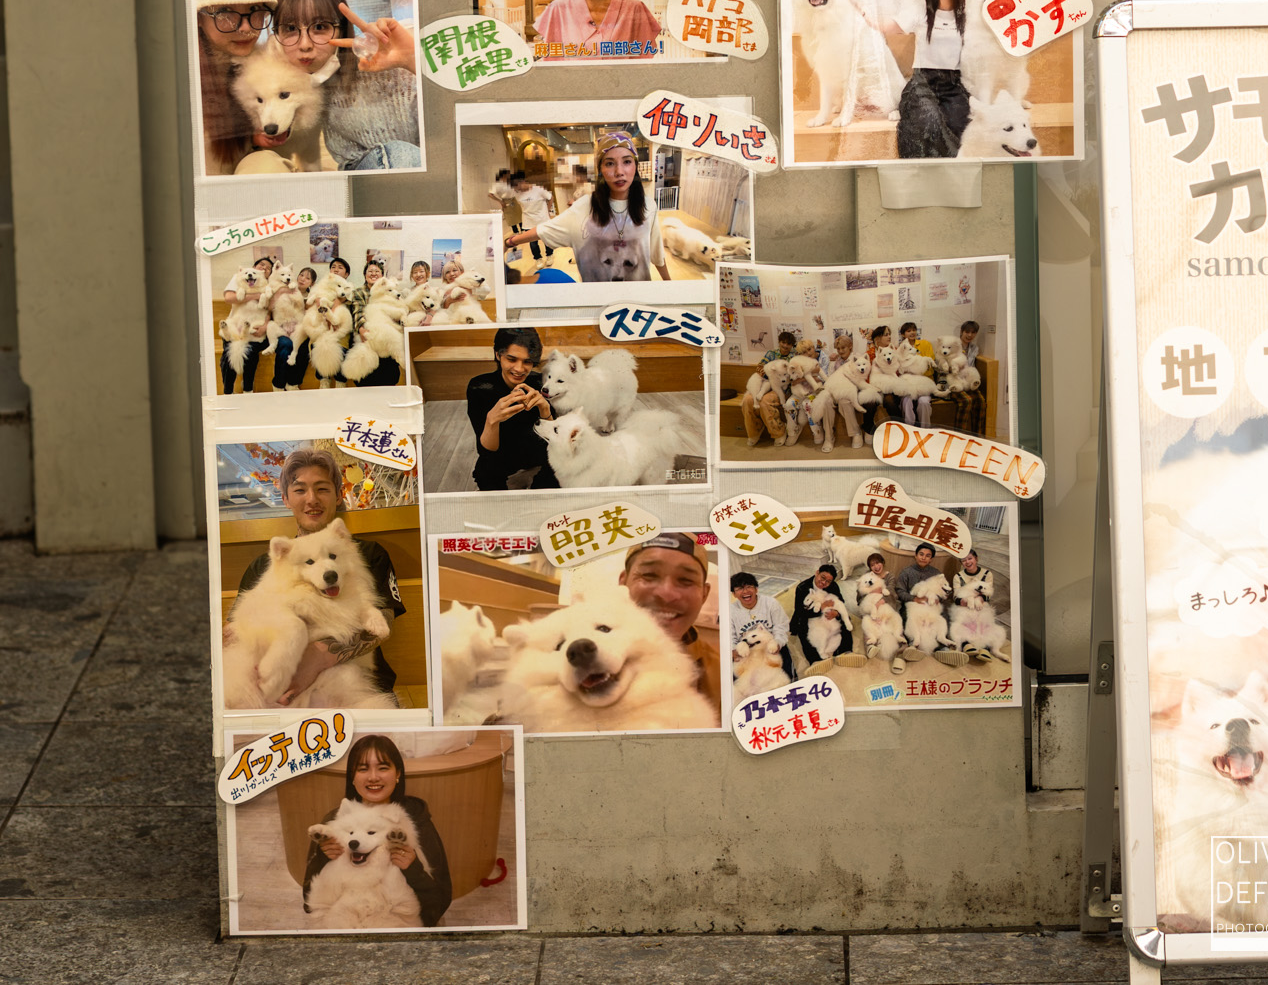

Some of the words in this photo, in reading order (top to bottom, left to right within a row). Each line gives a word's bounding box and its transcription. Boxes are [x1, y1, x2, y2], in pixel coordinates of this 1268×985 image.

[420, 19, 501, 74] 関根
[882, 421, 1039, 485] DXTEEN
[865, 480, 897, 500] 俳優
[712, 497, 757, 523] お笑い芸人
[442, 535, 538, 552] 照英とサモエド
[905, 677, 1013, 697] 王様のブランチ
